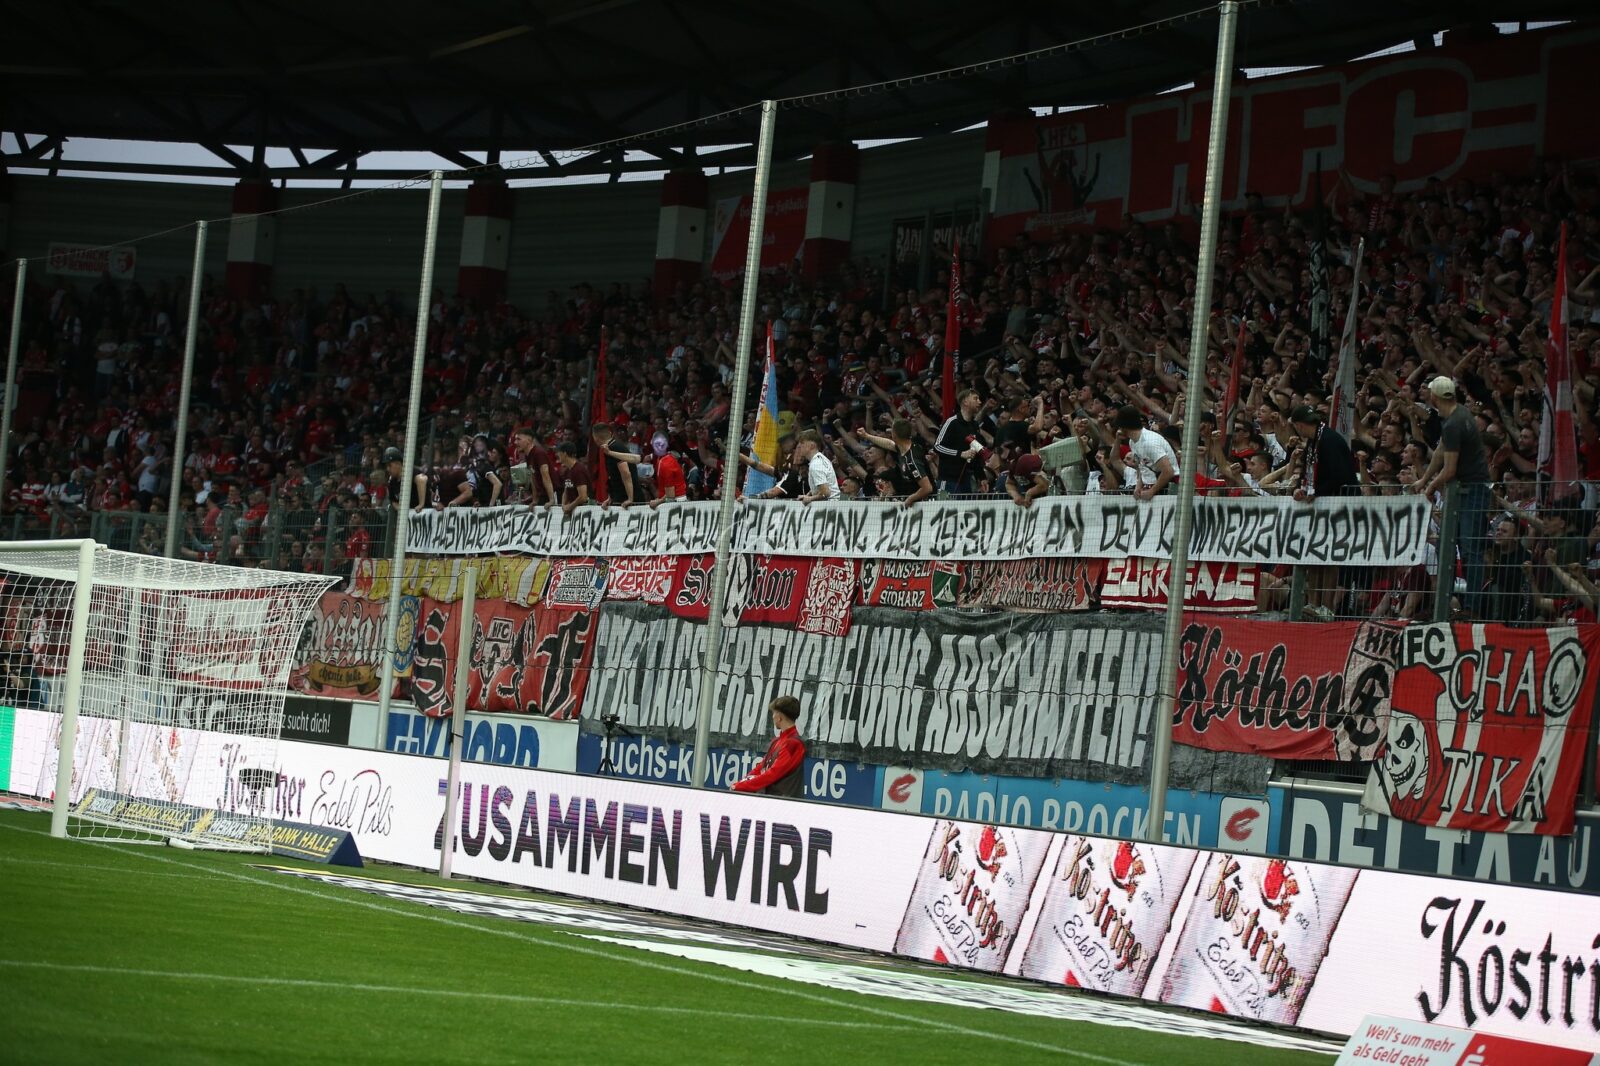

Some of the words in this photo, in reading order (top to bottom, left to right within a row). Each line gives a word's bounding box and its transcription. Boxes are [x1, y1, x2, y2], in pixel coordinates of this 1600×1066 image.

[407, 512, 433, 548] VOM
[811, 505, 868, 553] DANK
[874, 503, 923, 557] FÜR
[1043, 502, 1085, 553] AN
[1100, 504, 1153, 554] DEN
[1155, 503, 1425, 562] KMMERZVERBAND!
[1400, 627, 1446, 666] FC
[1173, 622, 1348, 734] Köthen
[287, 710, 309, 732] sucht
[310, 712, 331, 733] dich!
[310, 769, 353, 829] Edel
[353, 769, 394, 837] Pils
[300, 830, 339, 851] HALLE
[433, 777, 682, 890] ZUSAMMEN
[1353, 1043, 1372, 1058] als
[1372, 1046, 1401, 1064] Geld
[1400, 1054, 1430, 1066] geht
[1365, 1023, 1401, 1043] Weil's
[1401, 1031, 1424, 1046] um
[1424, 1034, 1457, 1054] mehr
